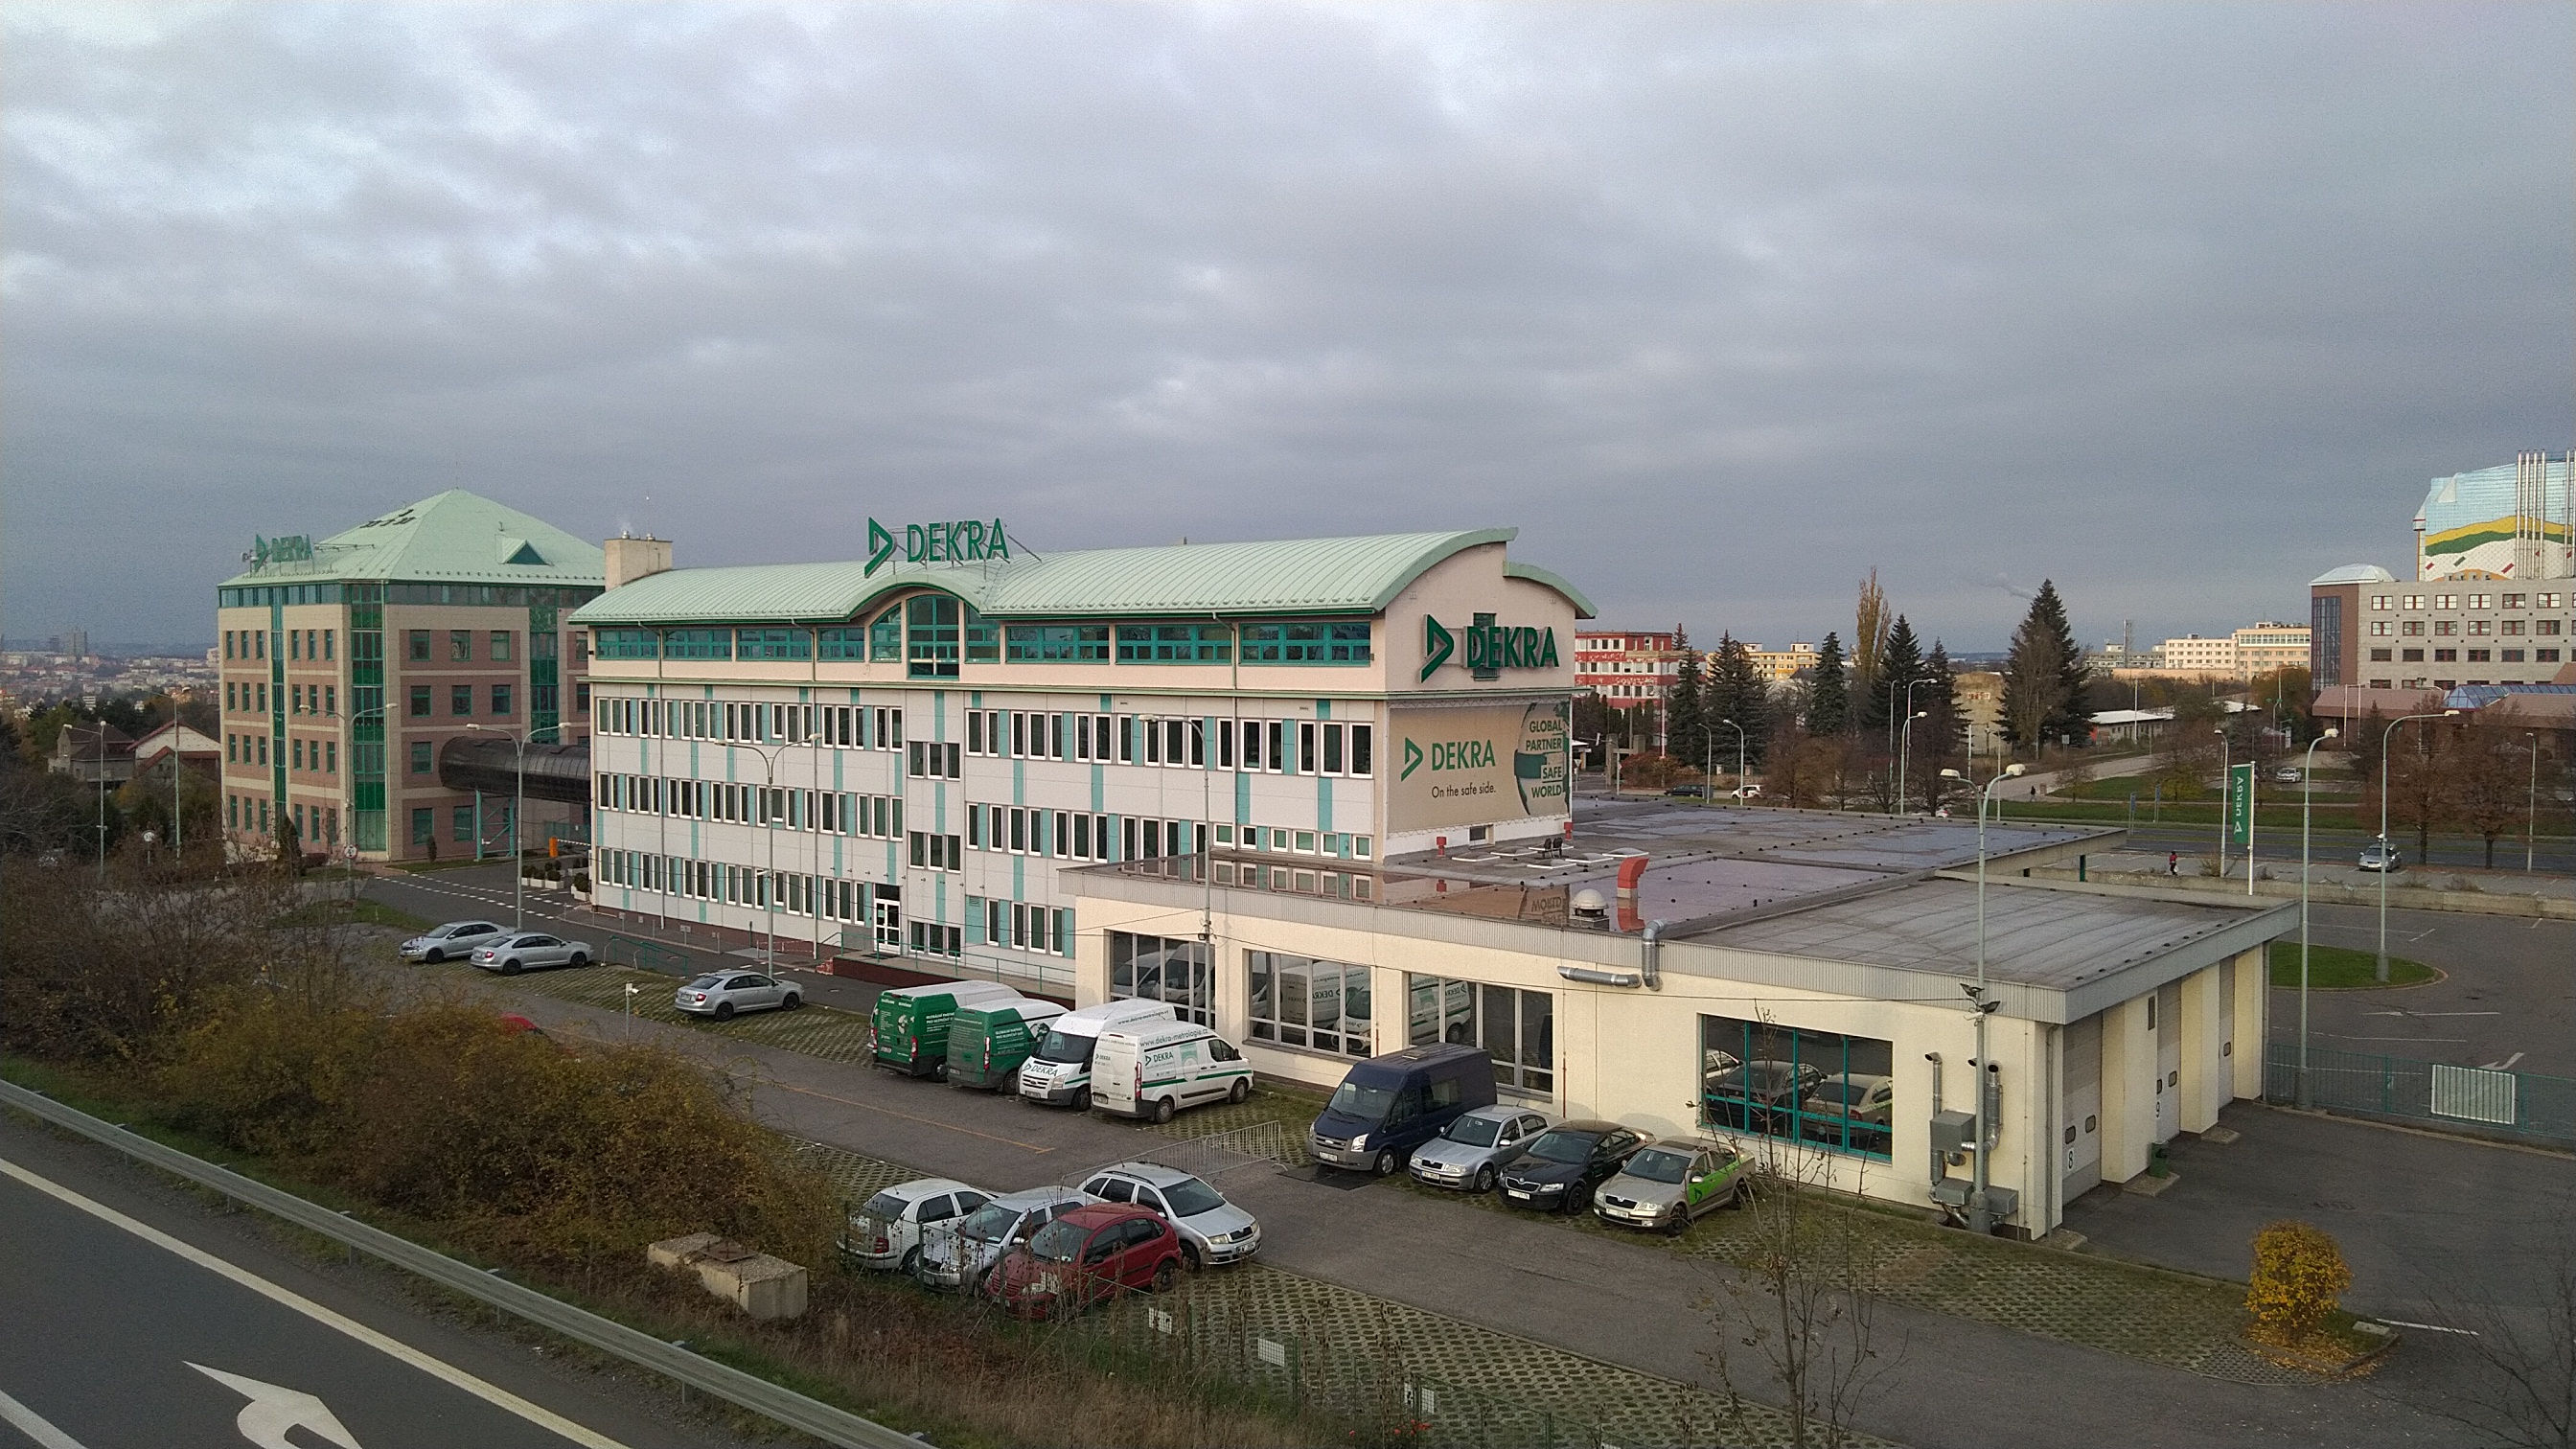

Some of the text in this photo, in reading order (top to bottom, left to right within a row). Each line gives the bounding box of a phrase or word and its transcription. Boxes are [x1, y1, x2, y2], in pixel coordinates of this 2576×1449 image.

[907, 518, 1010, 563] DEKRA
[1465, 626, 1560, 668] DEKRA
[1530, 721, 1563, 733] GLOBAL
[1526, 738, 1562, 751] PARTNER
[1432, 739, 1496, 771] DEKRA
[1542, 767, 1562, 779] SAFE
[1432, 781, 1497, 798] On the safe side.
[1531, 785, 1562, 798] WORLD
[1139, 1028, 1208, 1047] www.dekra-metrologie.cz
[1153, 1051, 1174, 1063] DEKRA
[1031, 1065, 1059, 1076] DEKRA
[2068, 1150, 2074, 1169] 8
